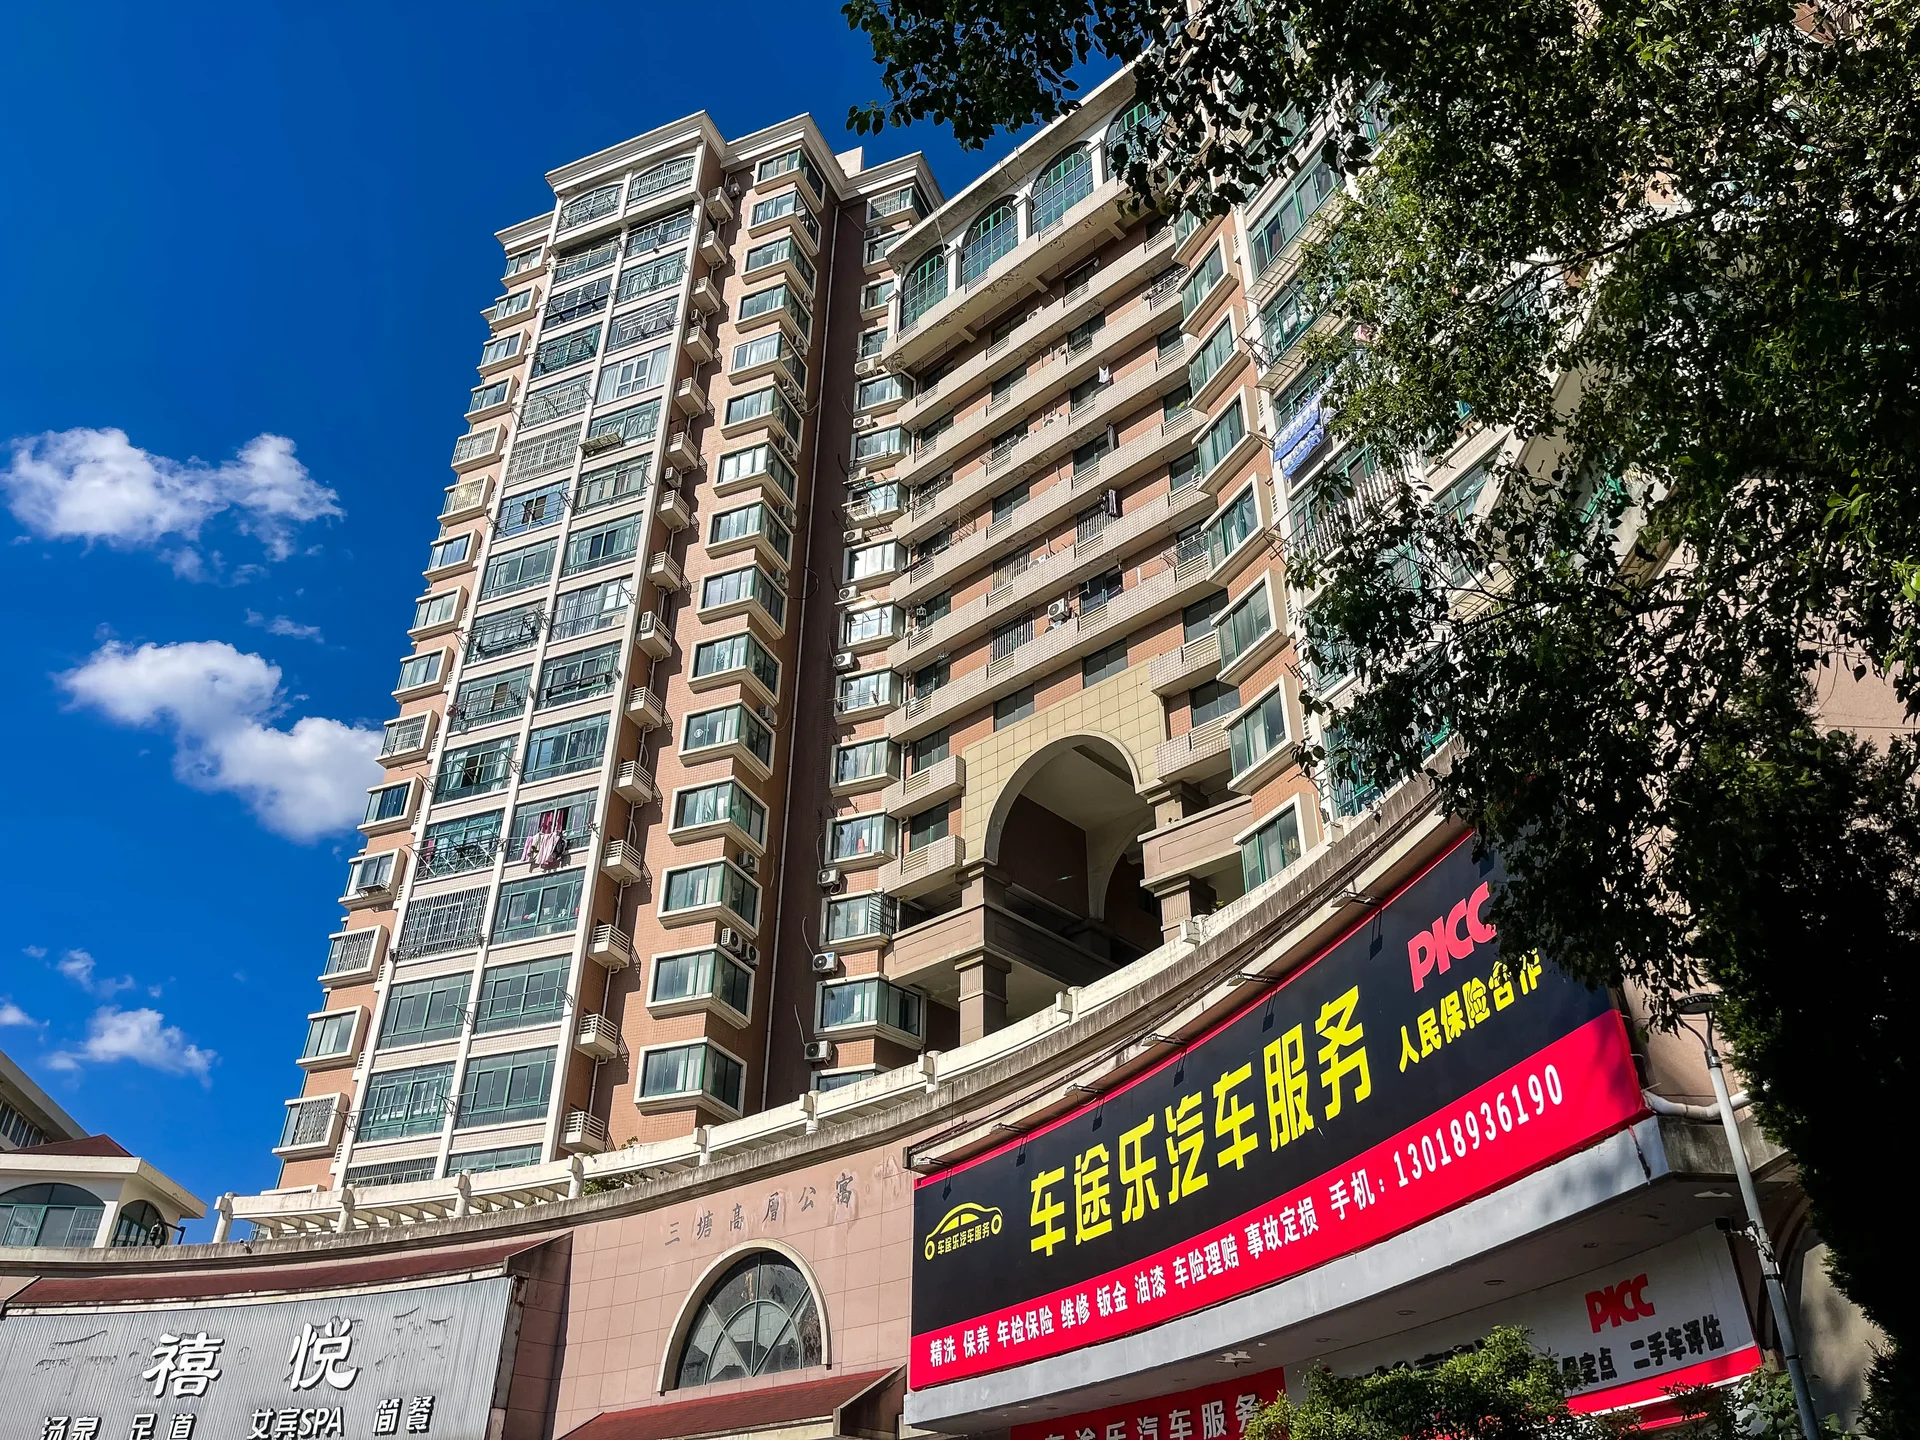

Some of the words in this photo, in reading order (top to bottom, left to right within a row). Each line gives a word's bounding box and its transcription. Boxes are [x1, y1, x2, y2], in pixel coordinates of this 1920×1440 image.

[1407, 881, 1497, 992] PICC
[1030, 984, 1372, 1257] 车途乐汽车服务
[937, 1221, 990, 1255] 车途乐汽车服务
[929, 1337, 957, 1367] 精洗
[963, 1324, 990, 1357] 保养
[996, 1306, 1055, 1349] 年检保险
[1060, 1298, 1090, 1330] 维修
[1097, 1280, 1127, 1317] 钣金
[1134, 1265, 1166, 1303] 油漆
[1172, 1233, 1239, 1290] 车险理赔
[1244, 1196, 1319, 1260] 事故定损
[1585, 1273, 1656, 1333] PICC
[143, 1319, 363, 1397] 禧悦
[1630, 1314, 1724, 1370] 二手车评估
[373, 1396, 433, 1433] 简餐
